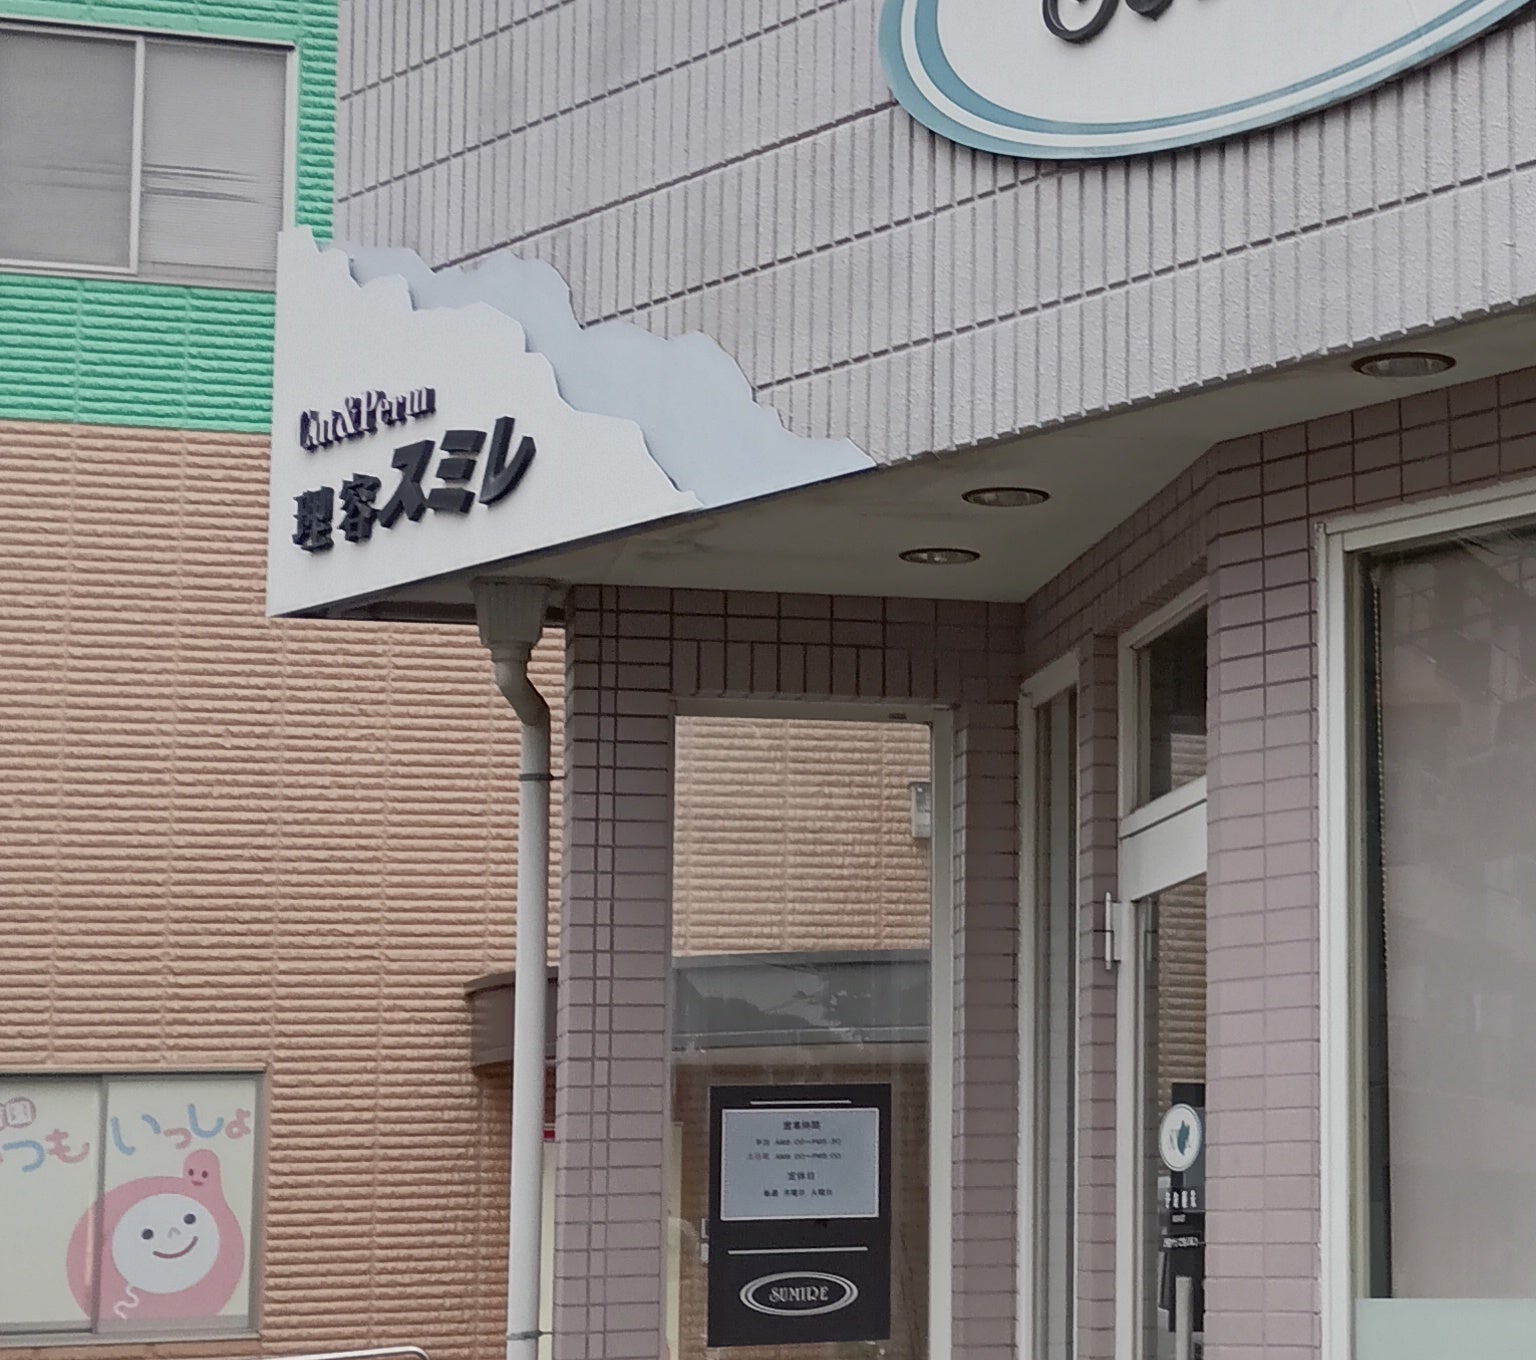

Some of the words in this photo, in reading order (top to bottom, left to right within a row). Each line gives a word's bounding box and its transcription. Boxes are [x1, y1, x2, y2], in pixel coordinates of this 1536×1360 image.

[110, 1103, 251, 1157] いっしょ
[768, 1285, 829, 1304] SUMIRE
